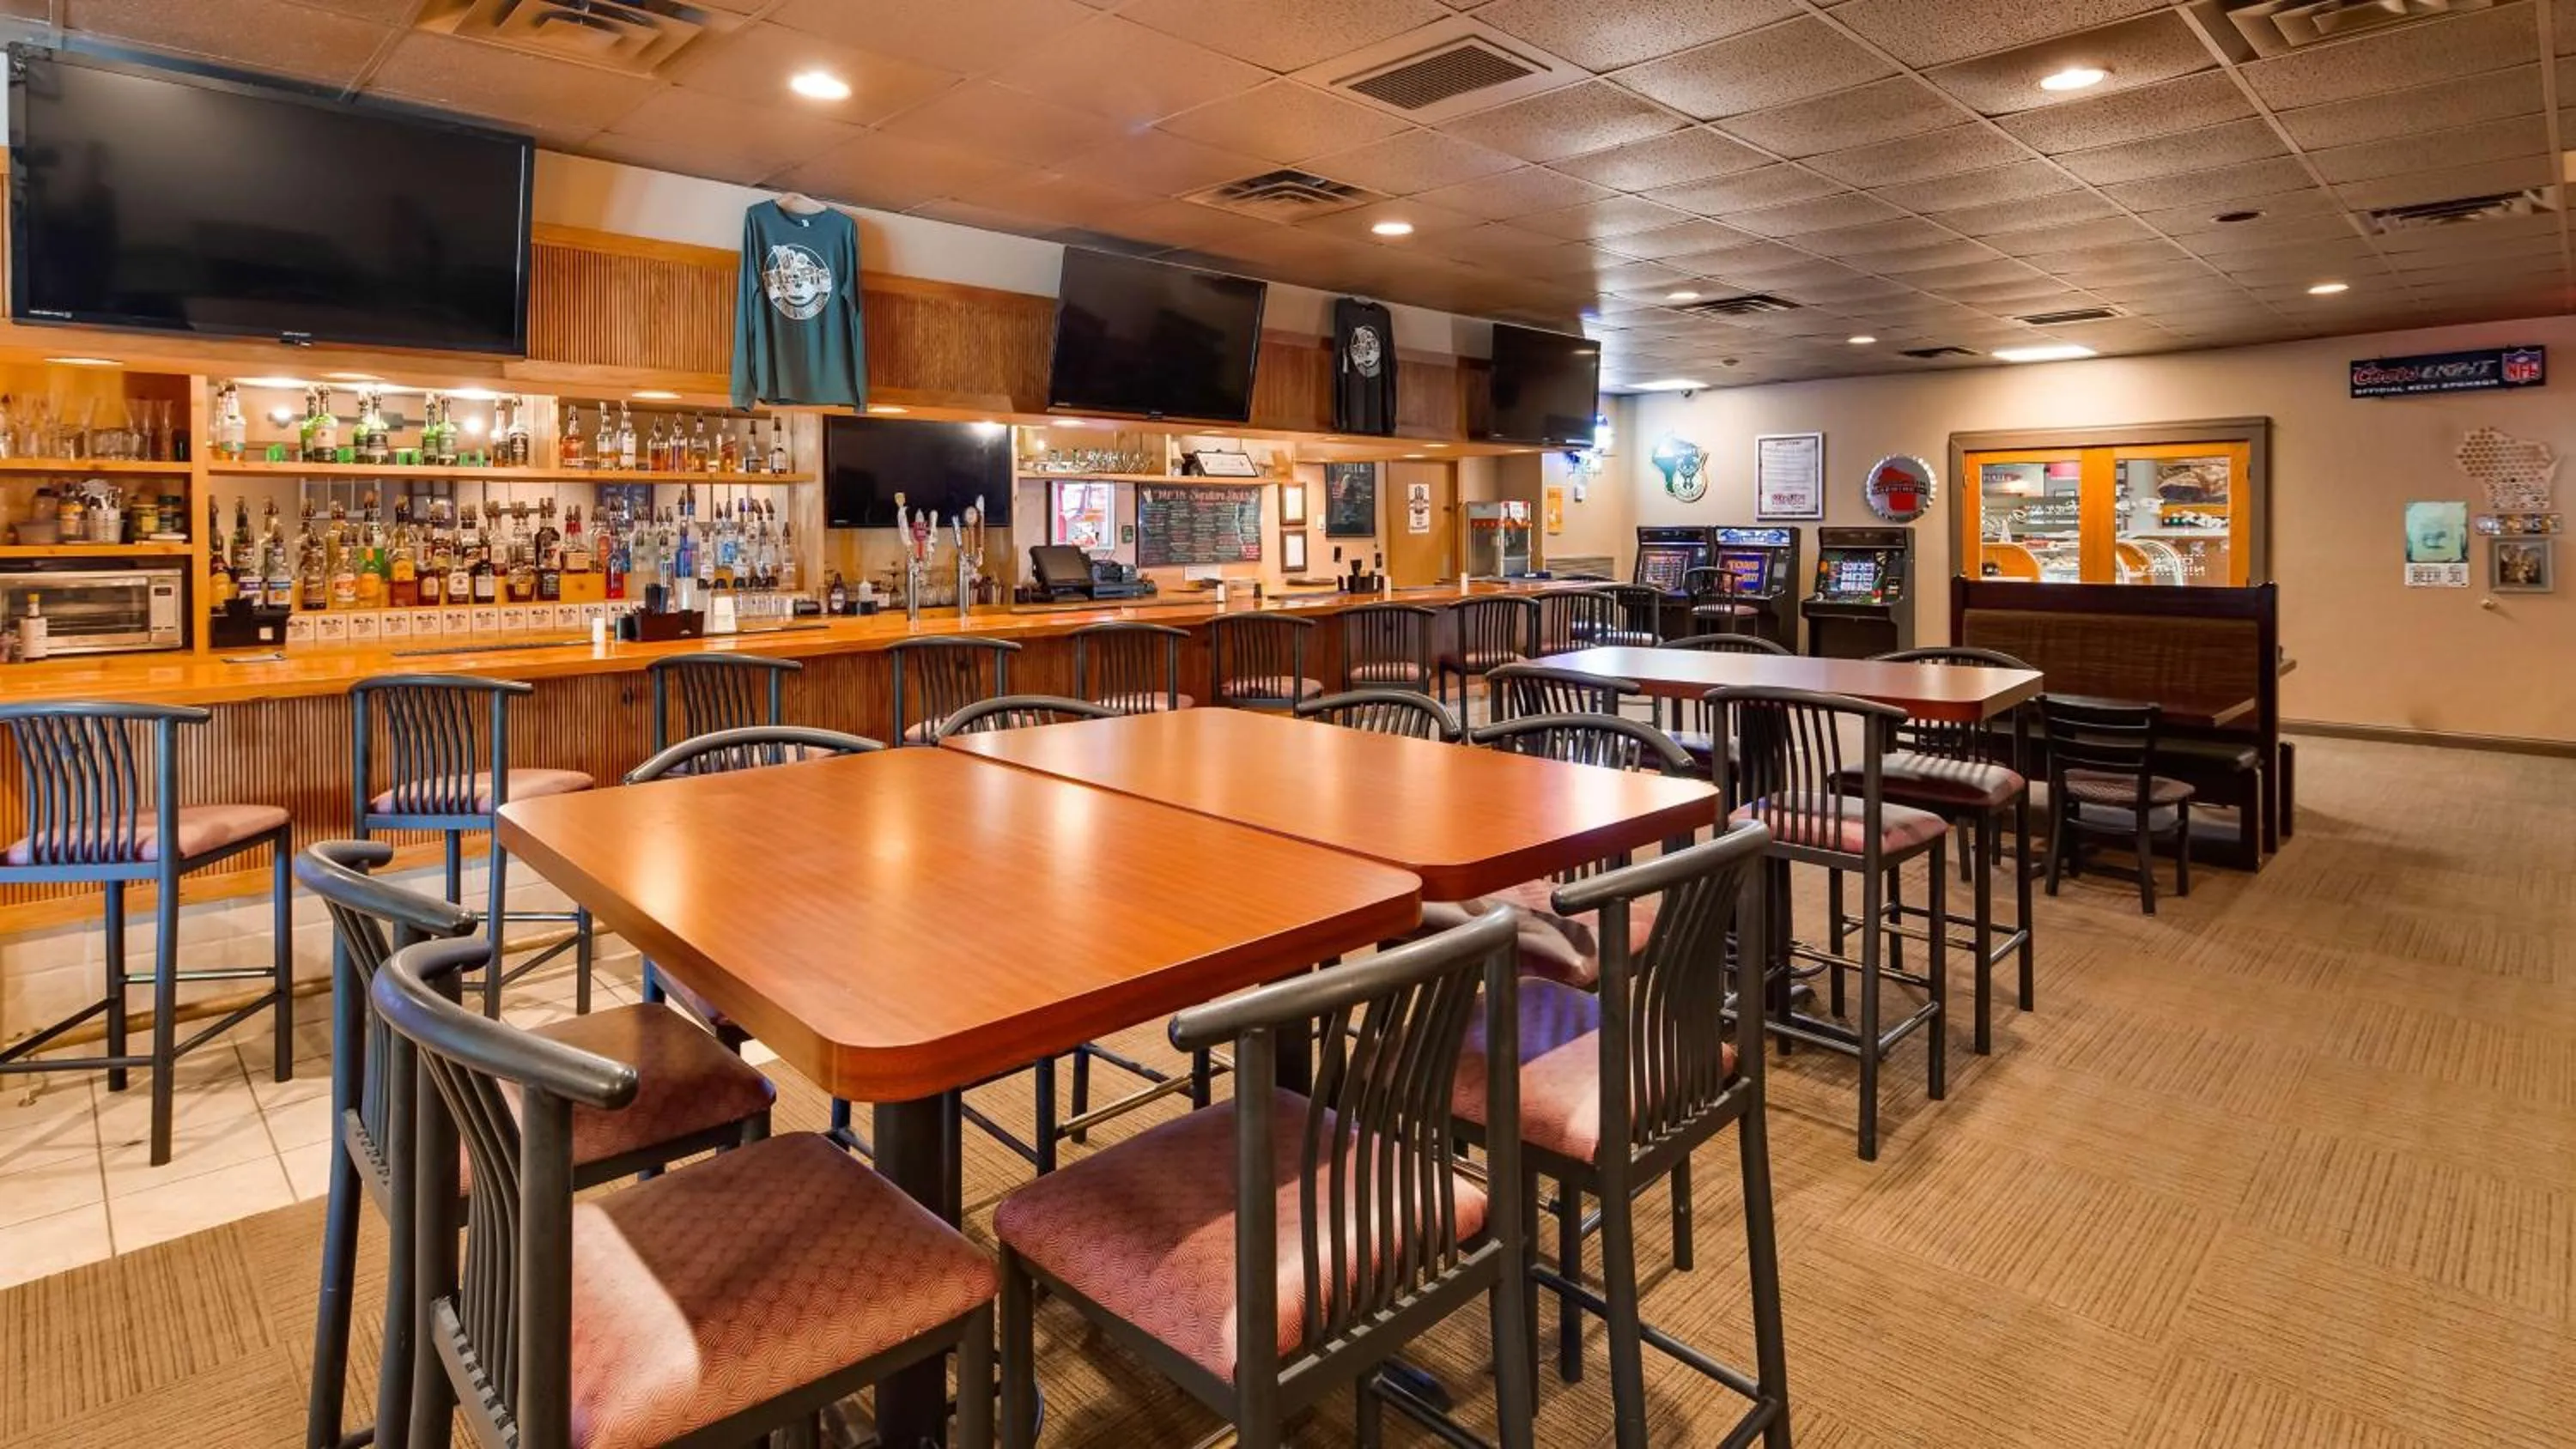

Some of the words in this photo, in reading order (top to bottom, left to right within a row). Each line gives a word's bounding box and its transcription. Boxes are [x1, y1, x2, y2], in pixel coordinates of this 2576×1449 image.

[2421, 360, 2498, 379] LIGHT
[2506, 362, 2540, 379] NFL
[2354, 386, 2403, 396] OFFICIAL
